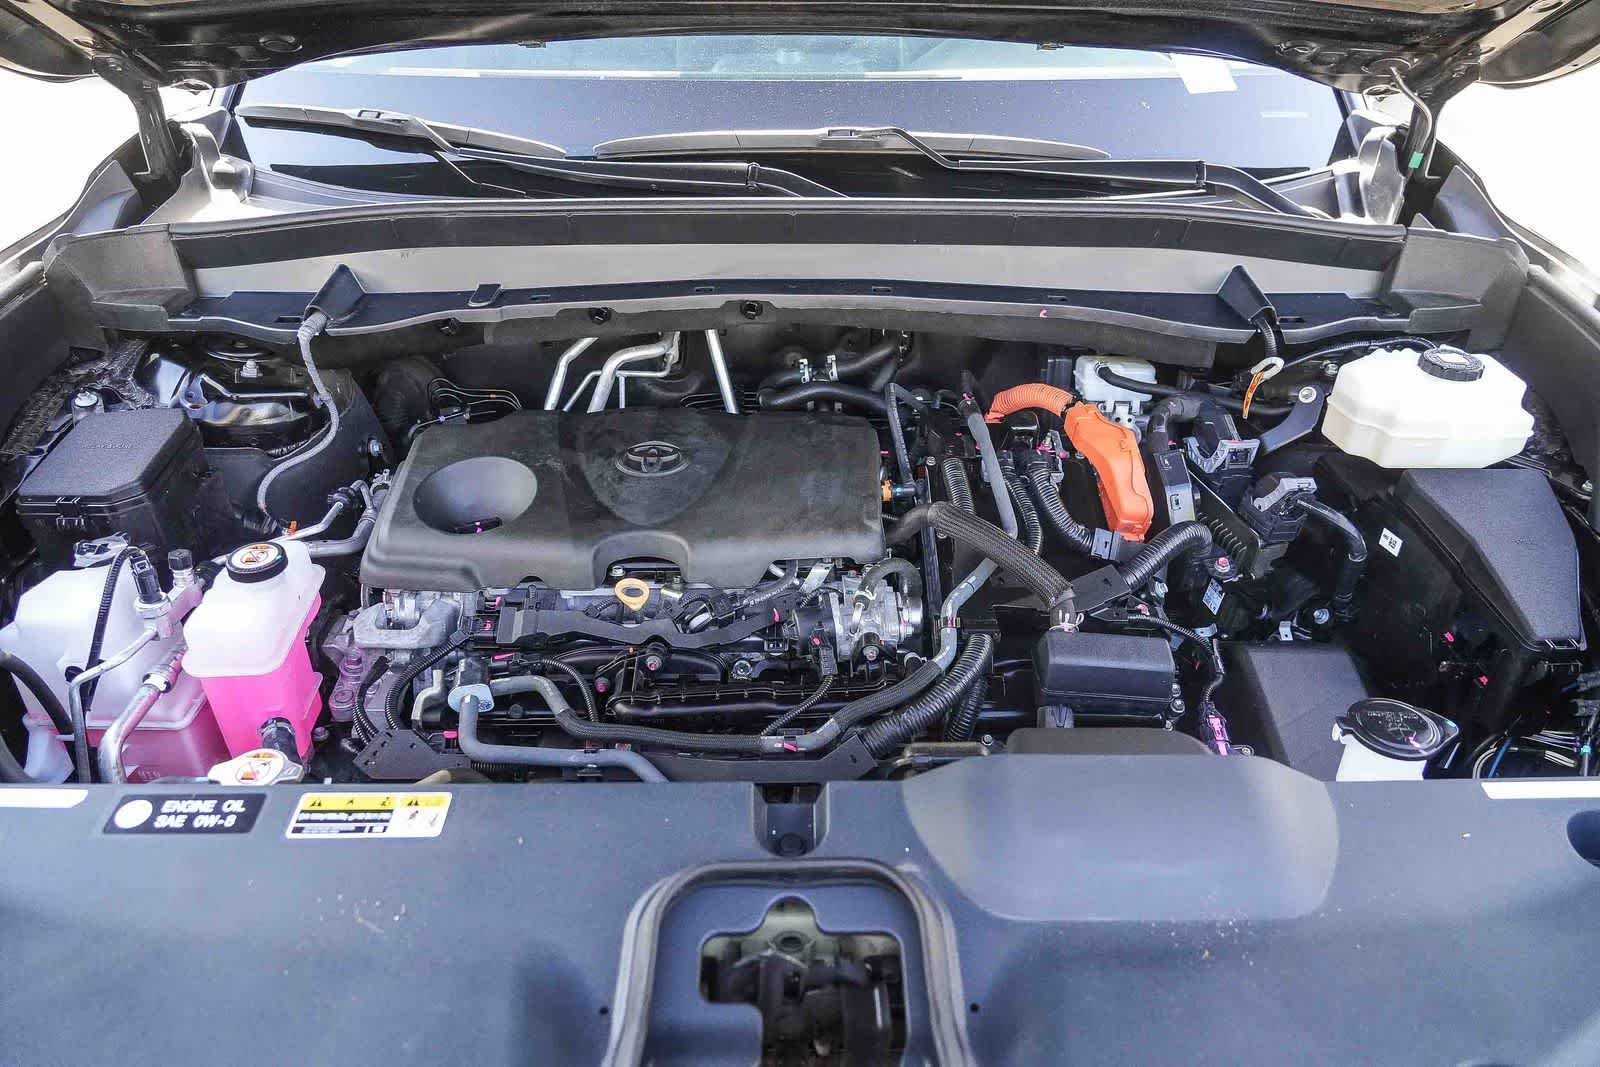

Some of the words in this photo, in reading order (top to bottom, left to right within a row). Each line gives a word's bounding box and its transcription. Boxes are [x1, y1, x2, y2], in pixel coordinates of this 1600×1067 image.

[161, 799, 218, 813] ENGINE
[221, 799, 246, 813] OIL
[153, 814, 188, 828] SAE
